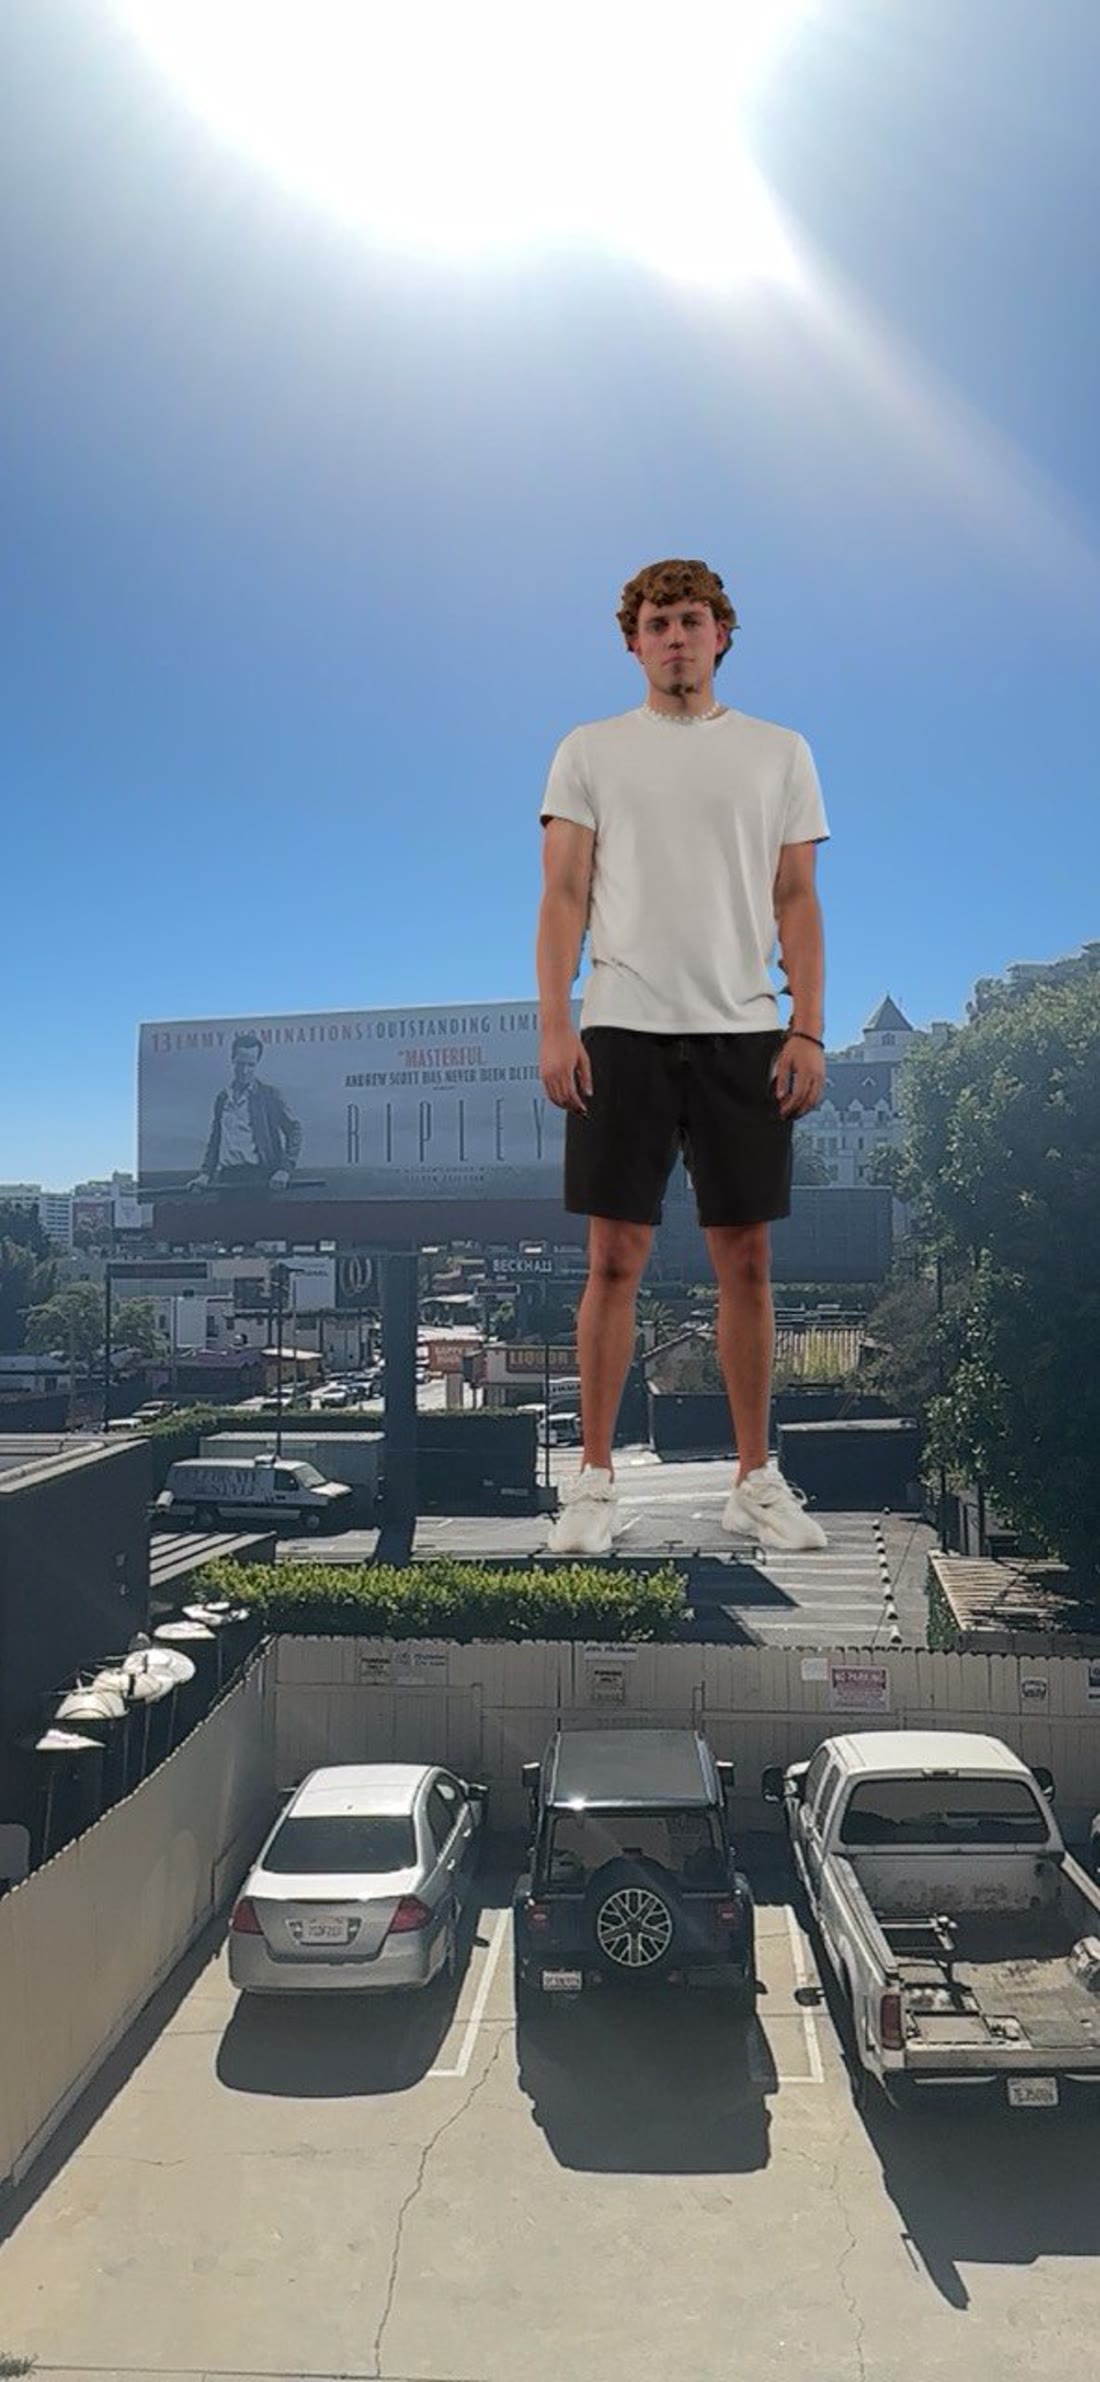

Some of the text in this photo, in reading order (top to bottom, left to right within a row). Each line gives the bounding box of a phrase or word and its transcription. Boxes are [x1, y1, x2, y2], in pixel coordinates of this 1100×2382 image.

[376, 1015, 491, 1039] OUTSTANDING
[500, 1012, 539, 1032] LIMI
[345, 1073, 387, 1088] ANDREW
[389, 1071, 419, 1086] SCOTT
[443, 1069, 477, 1084] NEVER
[347, 1098, 545, 1164] RIPLEY
[510, 1350, 569, 1365] LIQUOR
